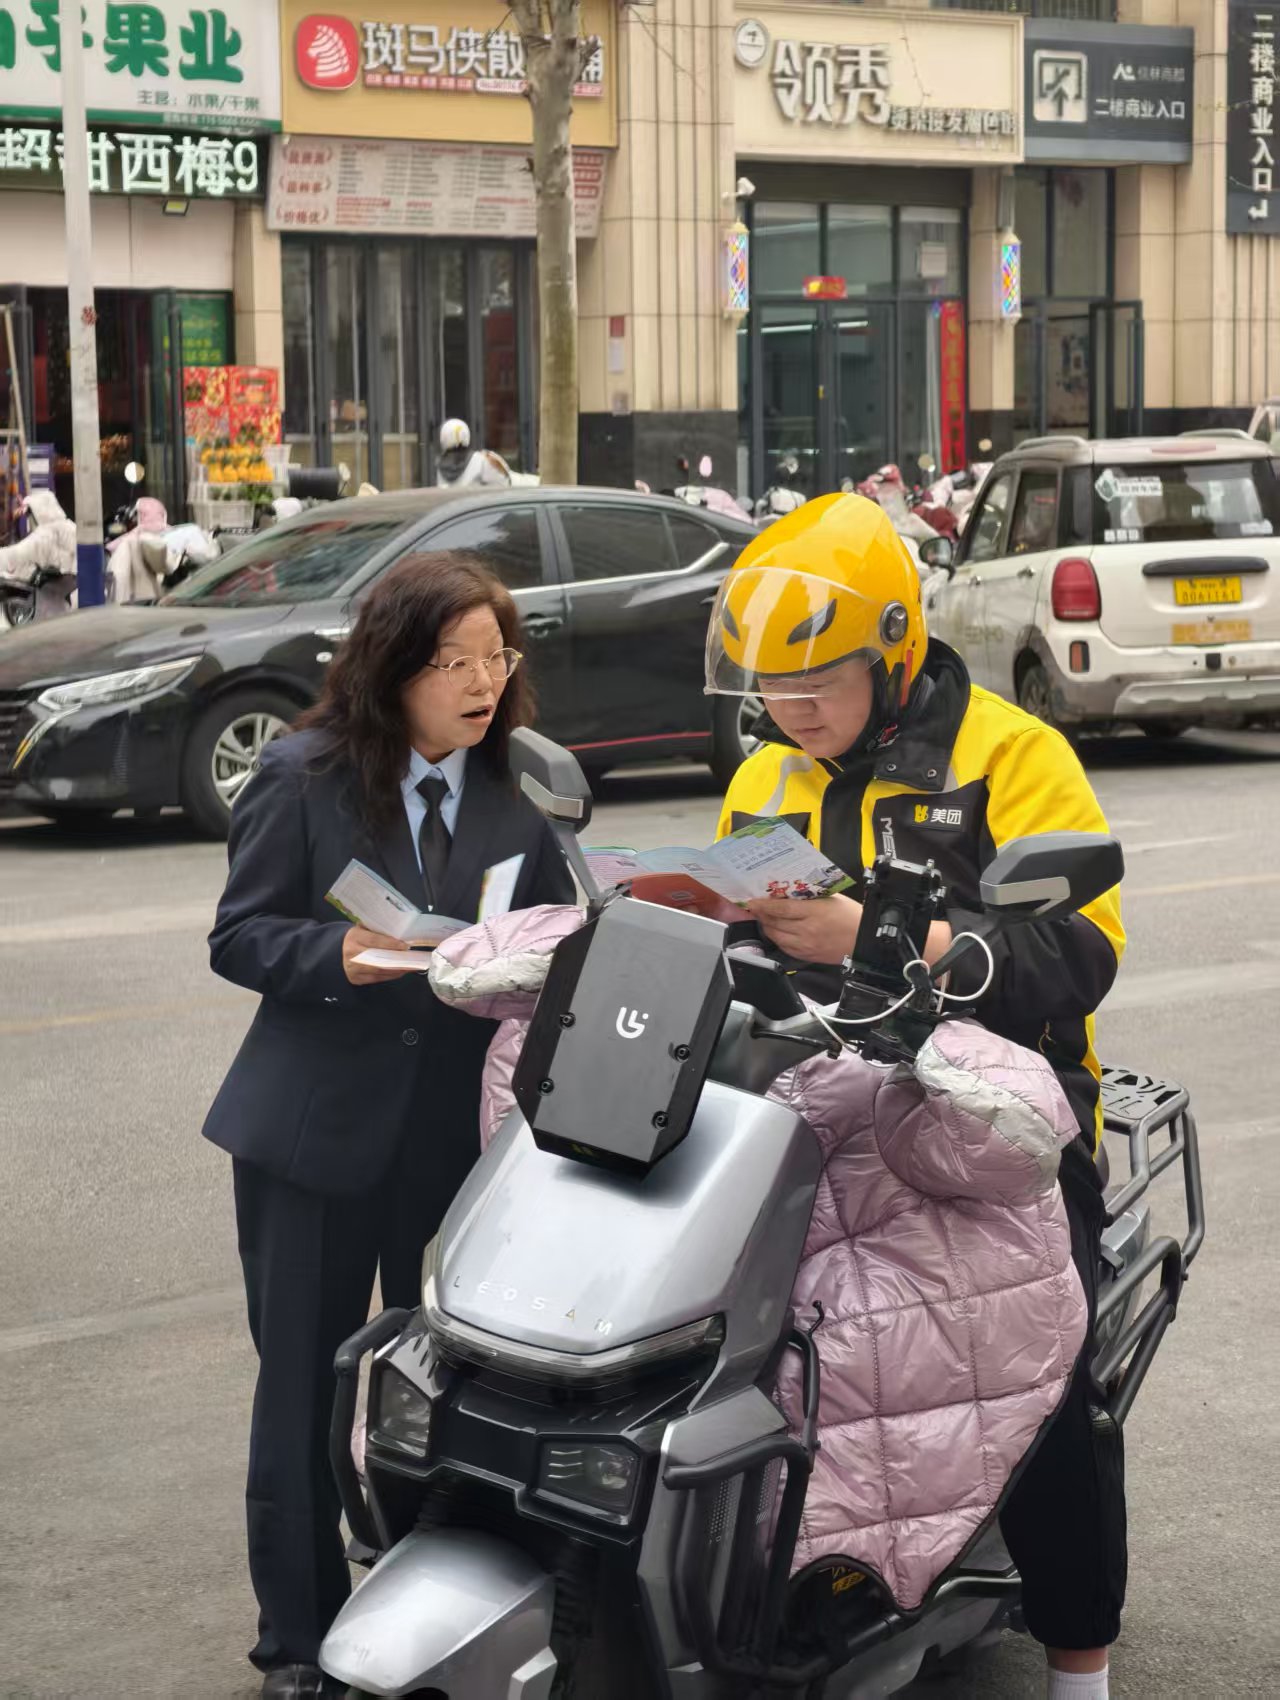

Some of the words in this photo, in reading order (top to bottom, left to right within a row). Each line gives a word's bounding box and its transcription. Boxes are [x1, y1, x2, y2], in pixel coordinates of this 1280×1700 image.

[363, 21, 605, 82] 斑马侠散
[771, 38, 891, 126] 领秀
[1094, 98, 1185, 119] 二楼商业入口
[1249, 14, 1274, 192] 二楼商业入口
[930, 808, 962, 825] 美团
[453, 1275, 613, 1336] LEOSAM
